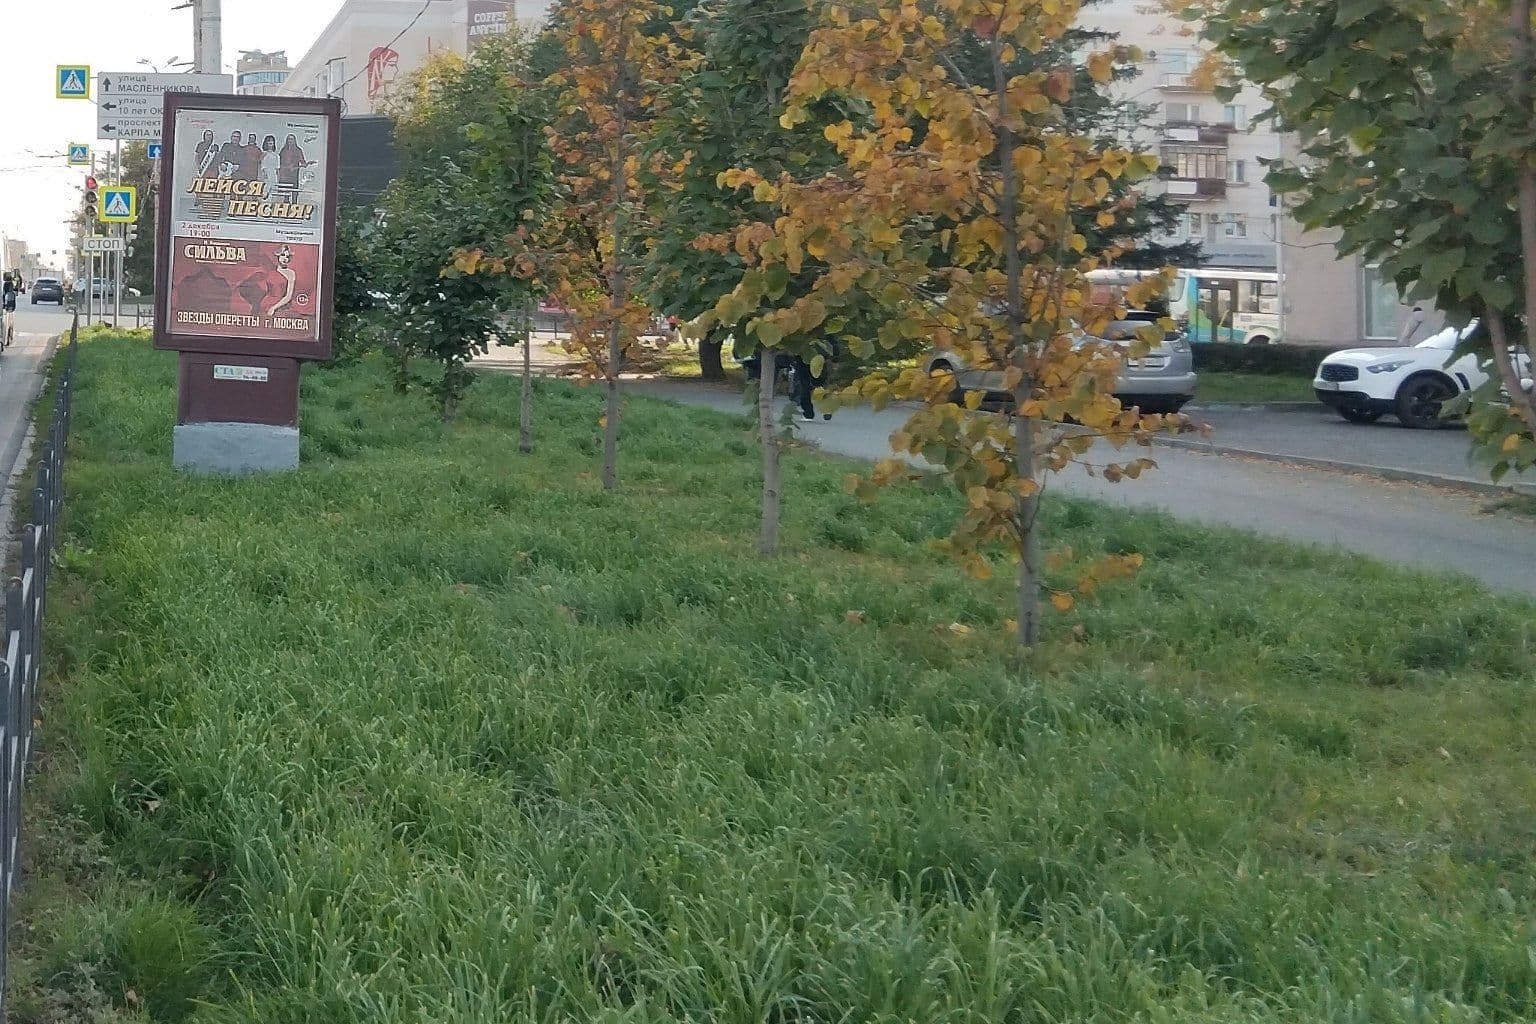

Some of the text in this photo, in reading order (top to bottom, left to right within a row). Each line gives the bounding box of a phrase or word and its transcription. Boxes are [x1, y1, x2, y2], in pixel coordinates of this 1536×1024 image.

[118, 84, 201, 93] МАСЛЕННИКОВА
[186, 176, 268, 200] ЛЕЙСЯ,
[227, 199, 314, 220] ПЕСНЯ!
[88, 239, 120, 249] СТОП
[184, 244, 247, 261] СИЛЬВА
[177, 311, 213, 325] ЗВЕЗДЫ
[215, 314, 260, 327] ОПЕРЕТТЫ
[273, 317, 309, 330] МОСКВА
